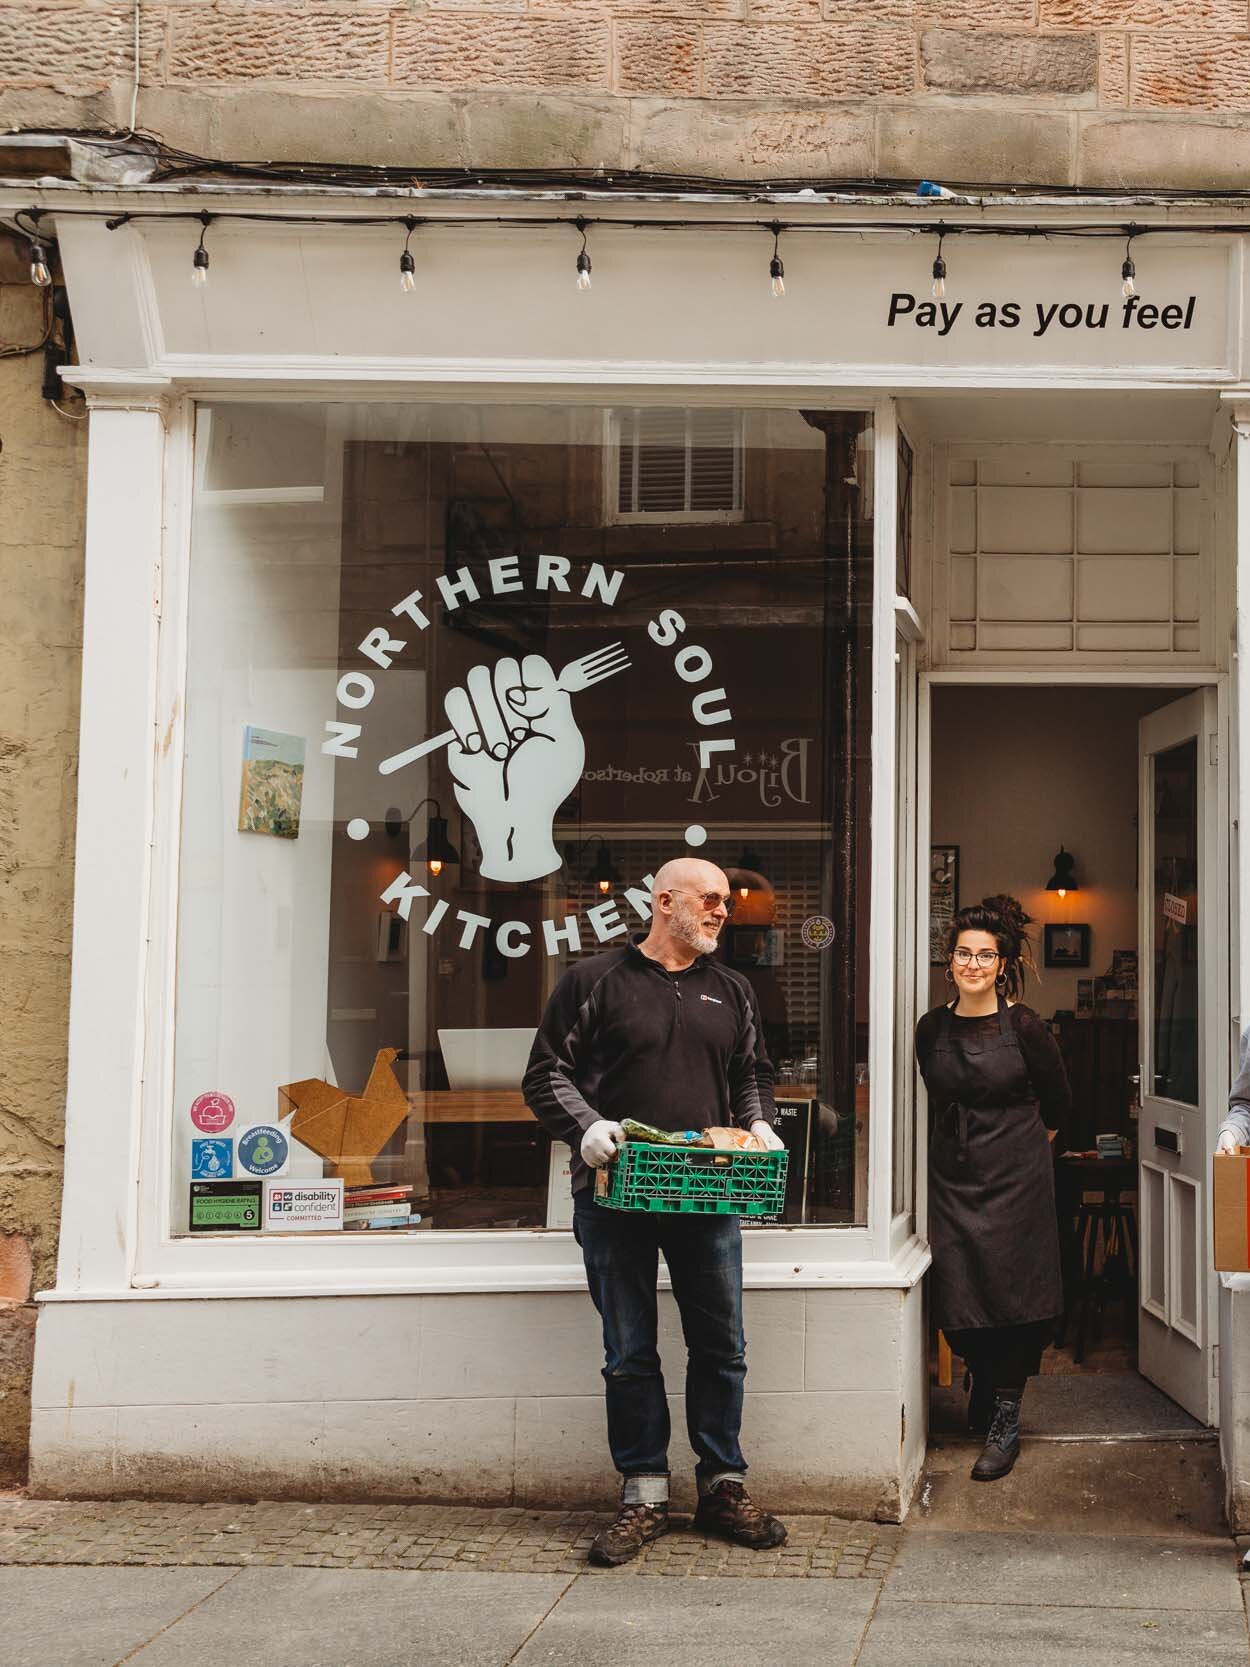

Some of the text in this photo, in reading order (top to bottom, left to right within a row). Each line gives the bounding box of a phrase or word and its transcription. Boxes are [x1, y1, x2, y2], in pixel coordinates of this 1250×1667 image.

[887, 293, 1197, 336] Pay as you feel
[321, 554, 736, 769] NORTHERN SOUL
[379, 871, 653, 959] KITCHEN
[1165, 898, 1185, 918] CLOSED
[781, 1107, 798, 1117] WASTE
[242, 1128, 283, 1146] Breastfeeding
[249, 1163, 278, 1174] Welcome
[294, 1191, 336, 1202] disability
[294, 1202, 336, 1212] confident
[245, 1210, 253, 1220] 5
